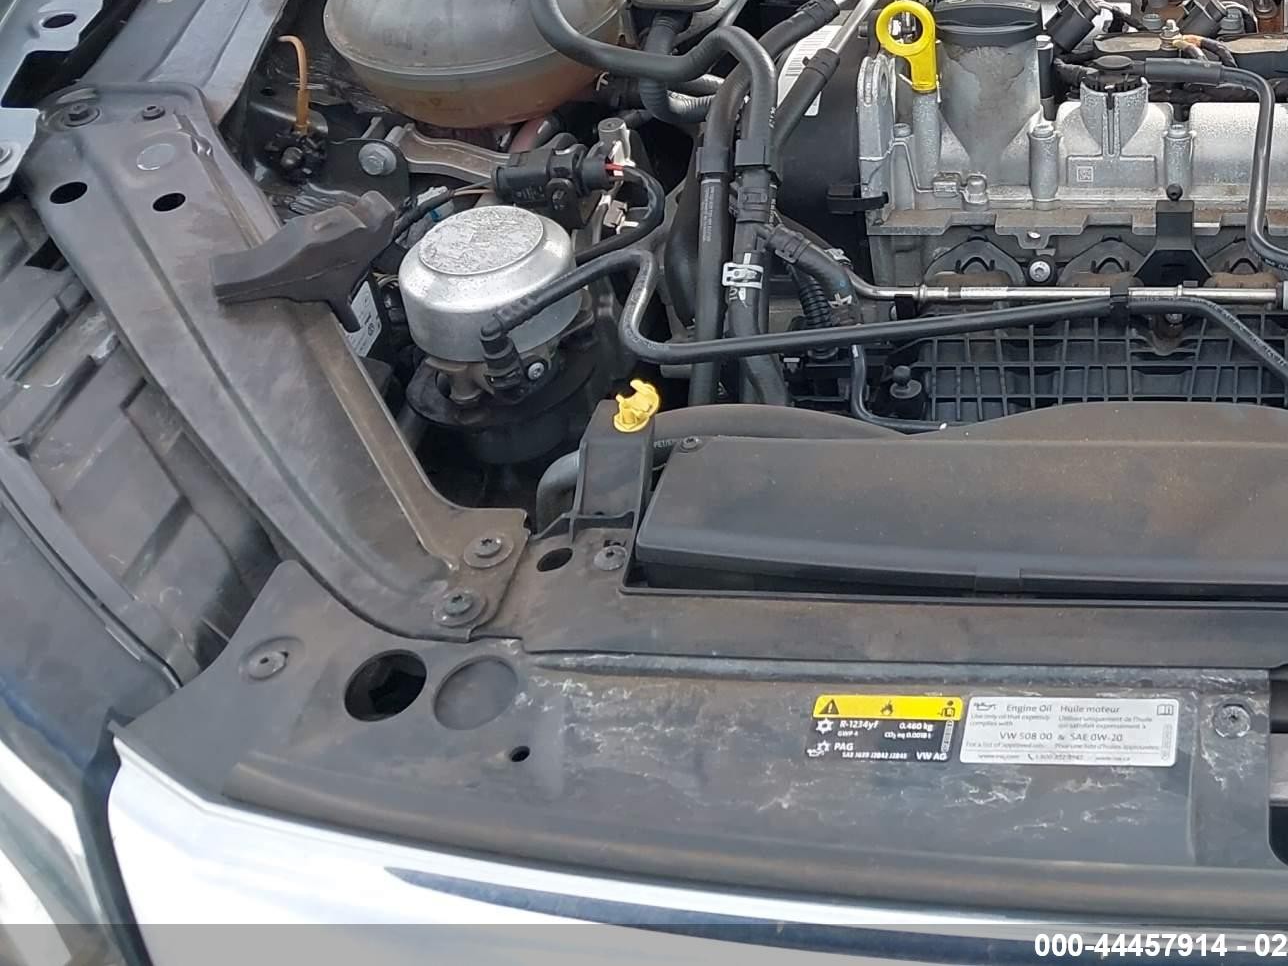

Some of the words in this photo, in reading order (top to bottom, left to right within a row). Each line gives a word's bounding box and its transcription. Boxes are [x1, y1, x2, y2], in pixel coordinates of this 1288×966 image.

[1006, 705, 1037, 713] Engine
[1060, 705, 1084, 713] Huile
[840, 720, 879, 730] R-1234yf
[899, 722, 922, 730] 0.460
[923, 722, 933, 731] kg
[1019, 732, 1037, 740] 508
[1039, 732, 1053, 740] 00
[1070, 733, 1086, 741] SAE
[834, 742, 853, 751] PAG
[916, 751, 932, 760] VW
[933, 752, 947, 761] AG
